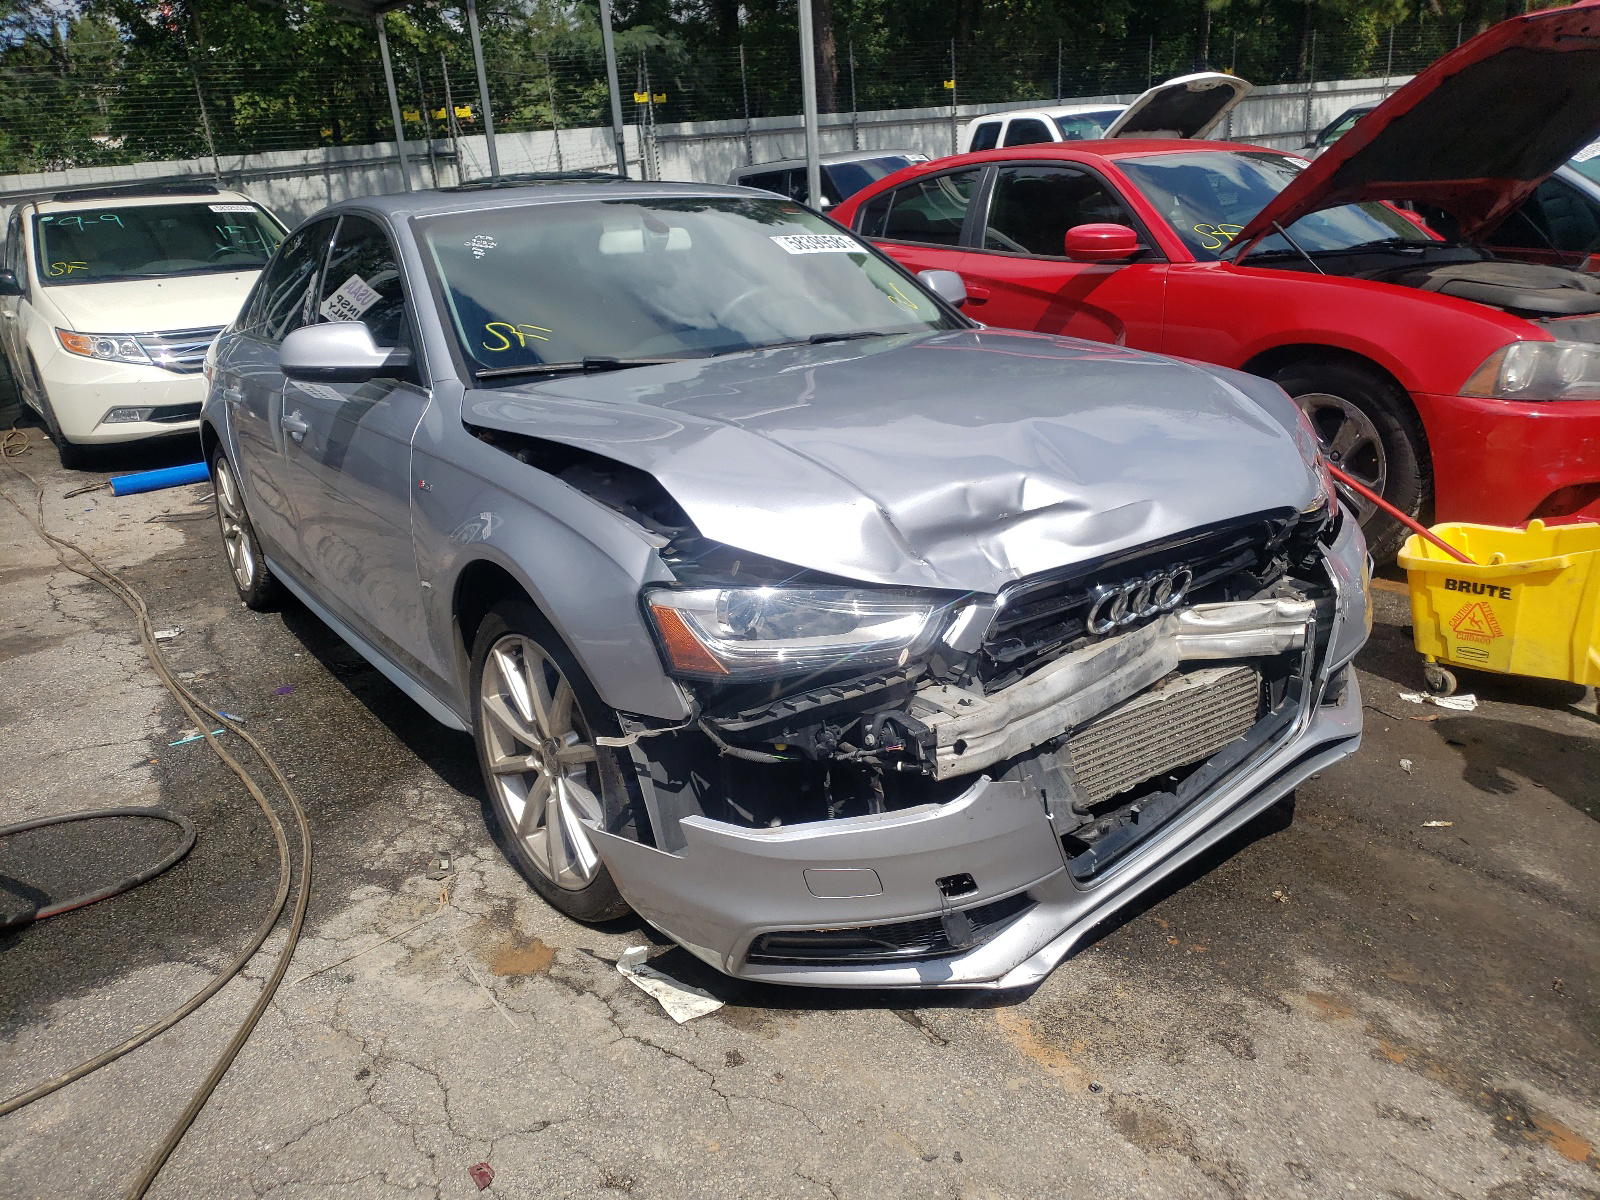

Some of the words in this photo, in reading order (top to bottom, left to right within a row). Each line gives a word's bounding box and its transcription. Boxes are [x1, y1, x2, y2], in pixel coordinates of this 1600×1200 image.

[50, 261, 88, 276] SF
[483, 322, 553, 351] SF
[1444, 577, 1512, 600] BRUTE
[1448, 601, 1473, 627] CAUTION
[1480, 601, 1504, 637] ATTENTION
